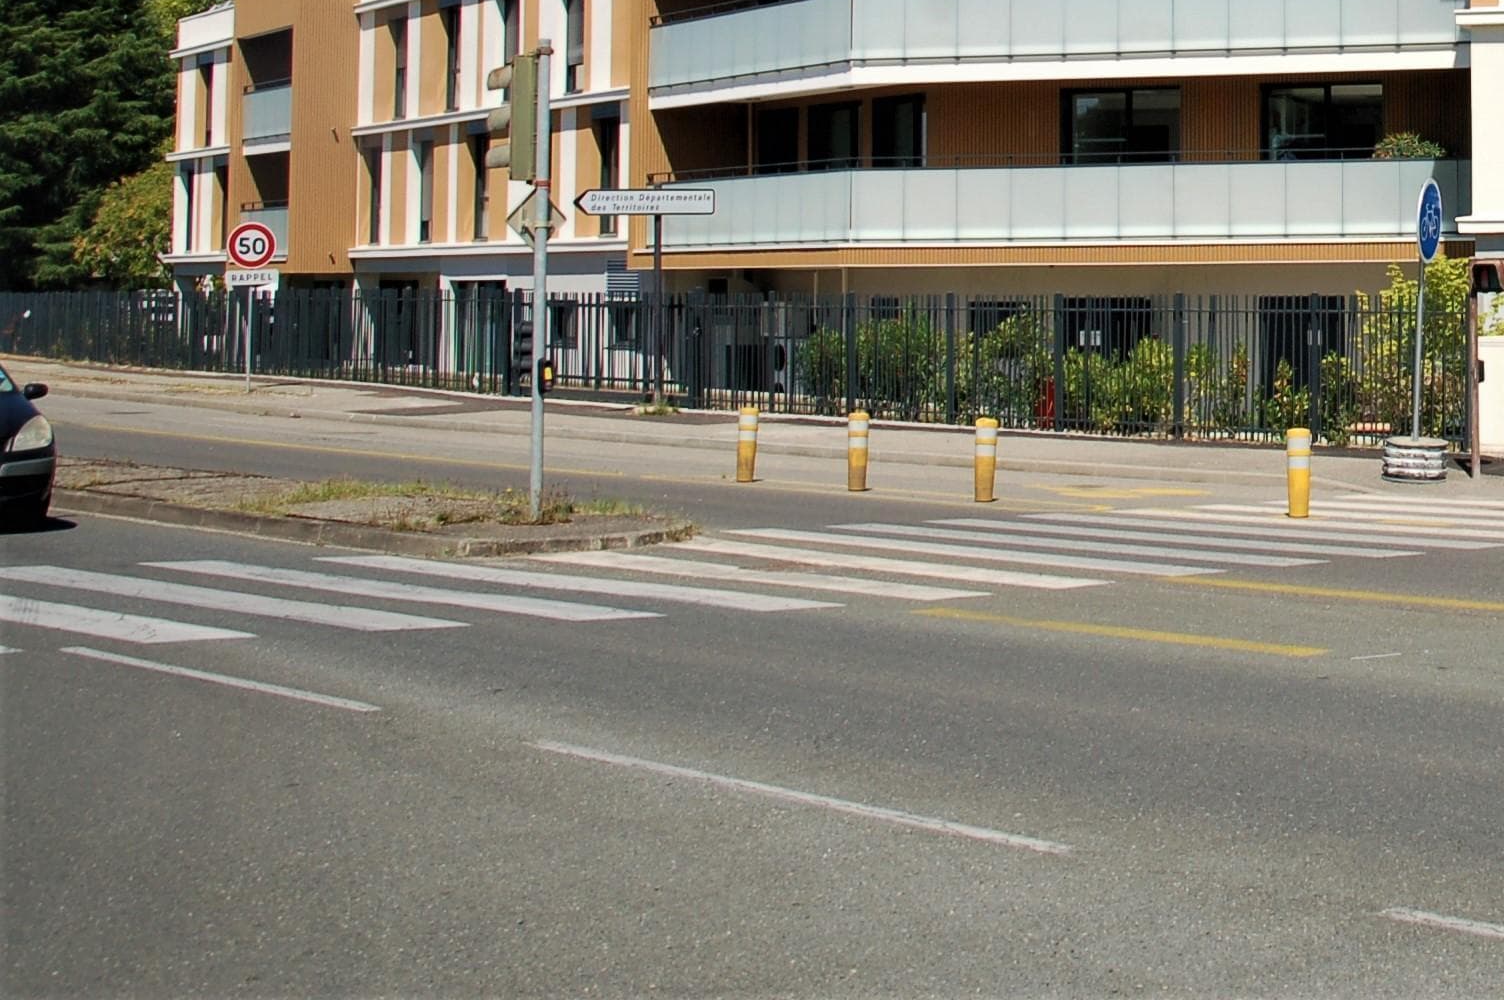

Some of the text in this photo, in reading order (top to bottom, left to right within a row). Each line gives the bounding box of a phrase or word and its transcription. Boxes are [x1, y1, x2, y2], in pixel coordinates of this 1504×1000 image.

[591, 192, 711, 203] Direction Départementale
[238, 237, 266, 254] 50
[231, 273, 273, 281] RAPPEL
